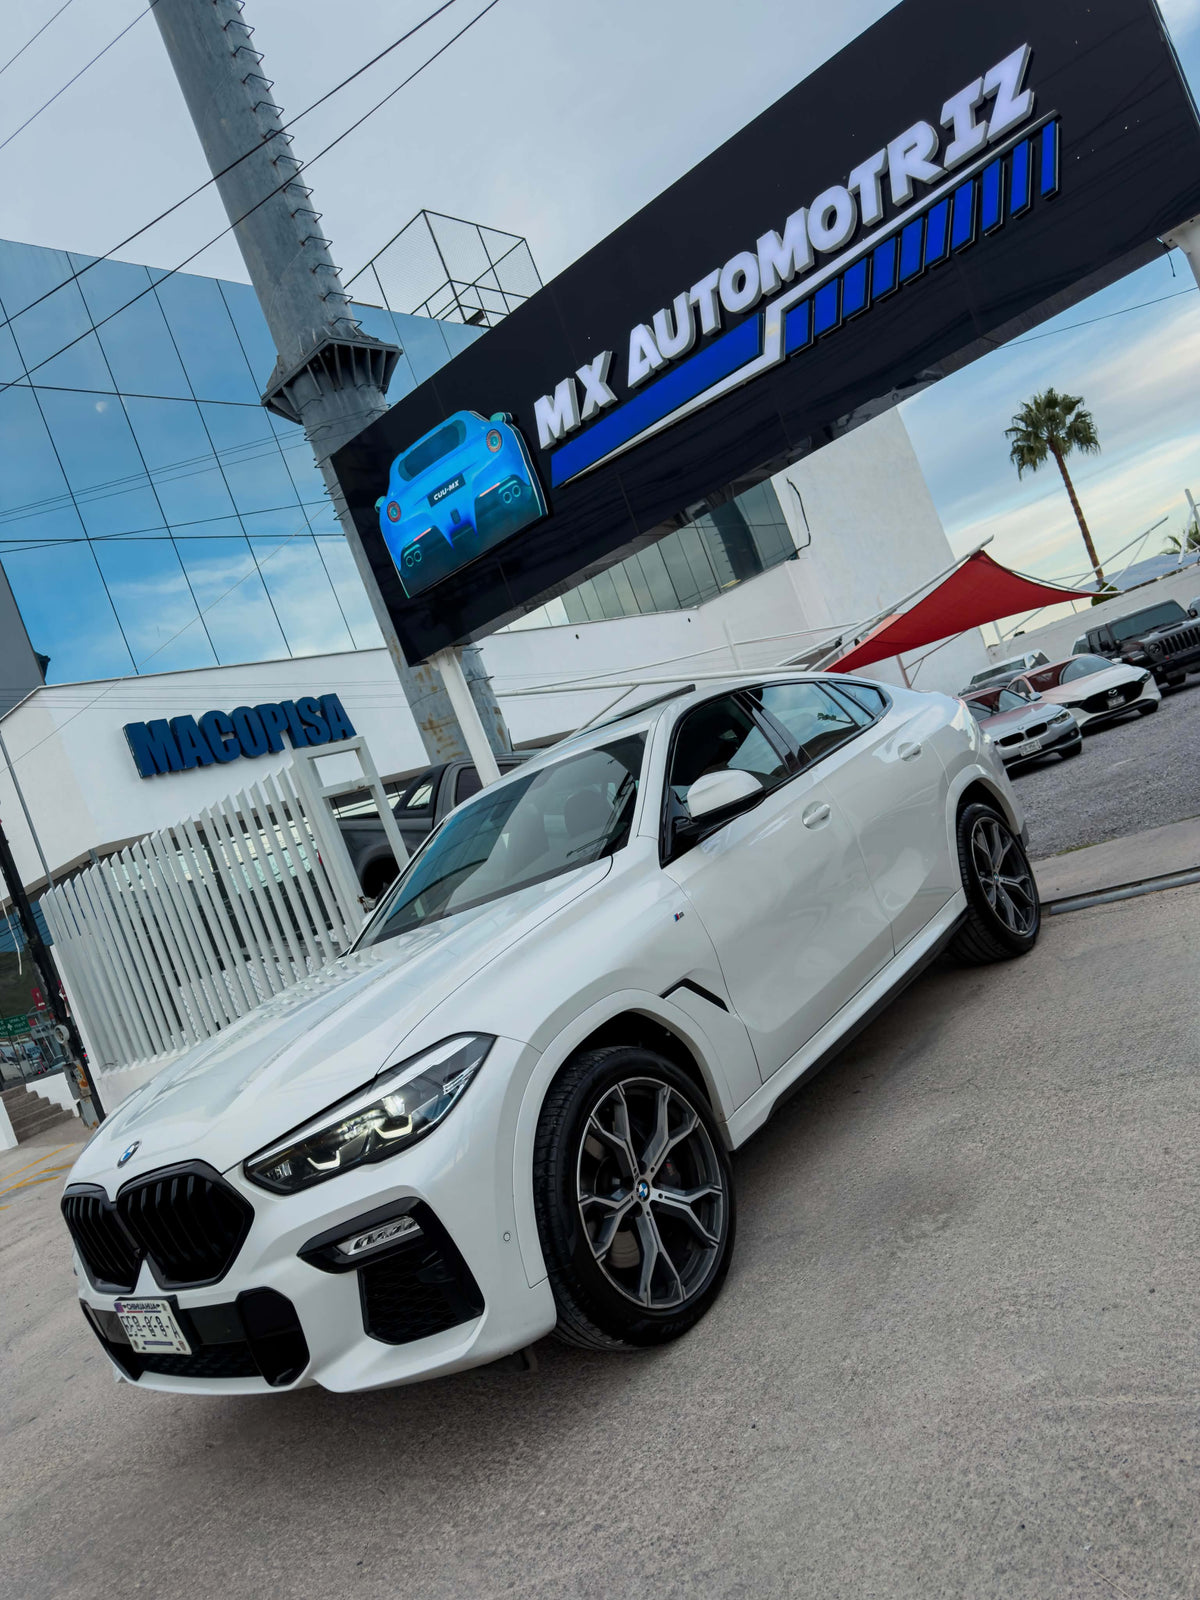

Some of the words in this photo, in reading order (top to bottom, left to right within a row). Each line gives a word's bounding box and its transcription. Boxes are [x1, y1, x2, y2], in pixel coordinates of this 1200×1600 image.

[534, 350, 618, 450] MX
[627, 43, 1035, 389] AUTOMOTRIZ
[433, 480, 459, 501] CUU-MX
[122, 692, 357, 779] MACOPISA
